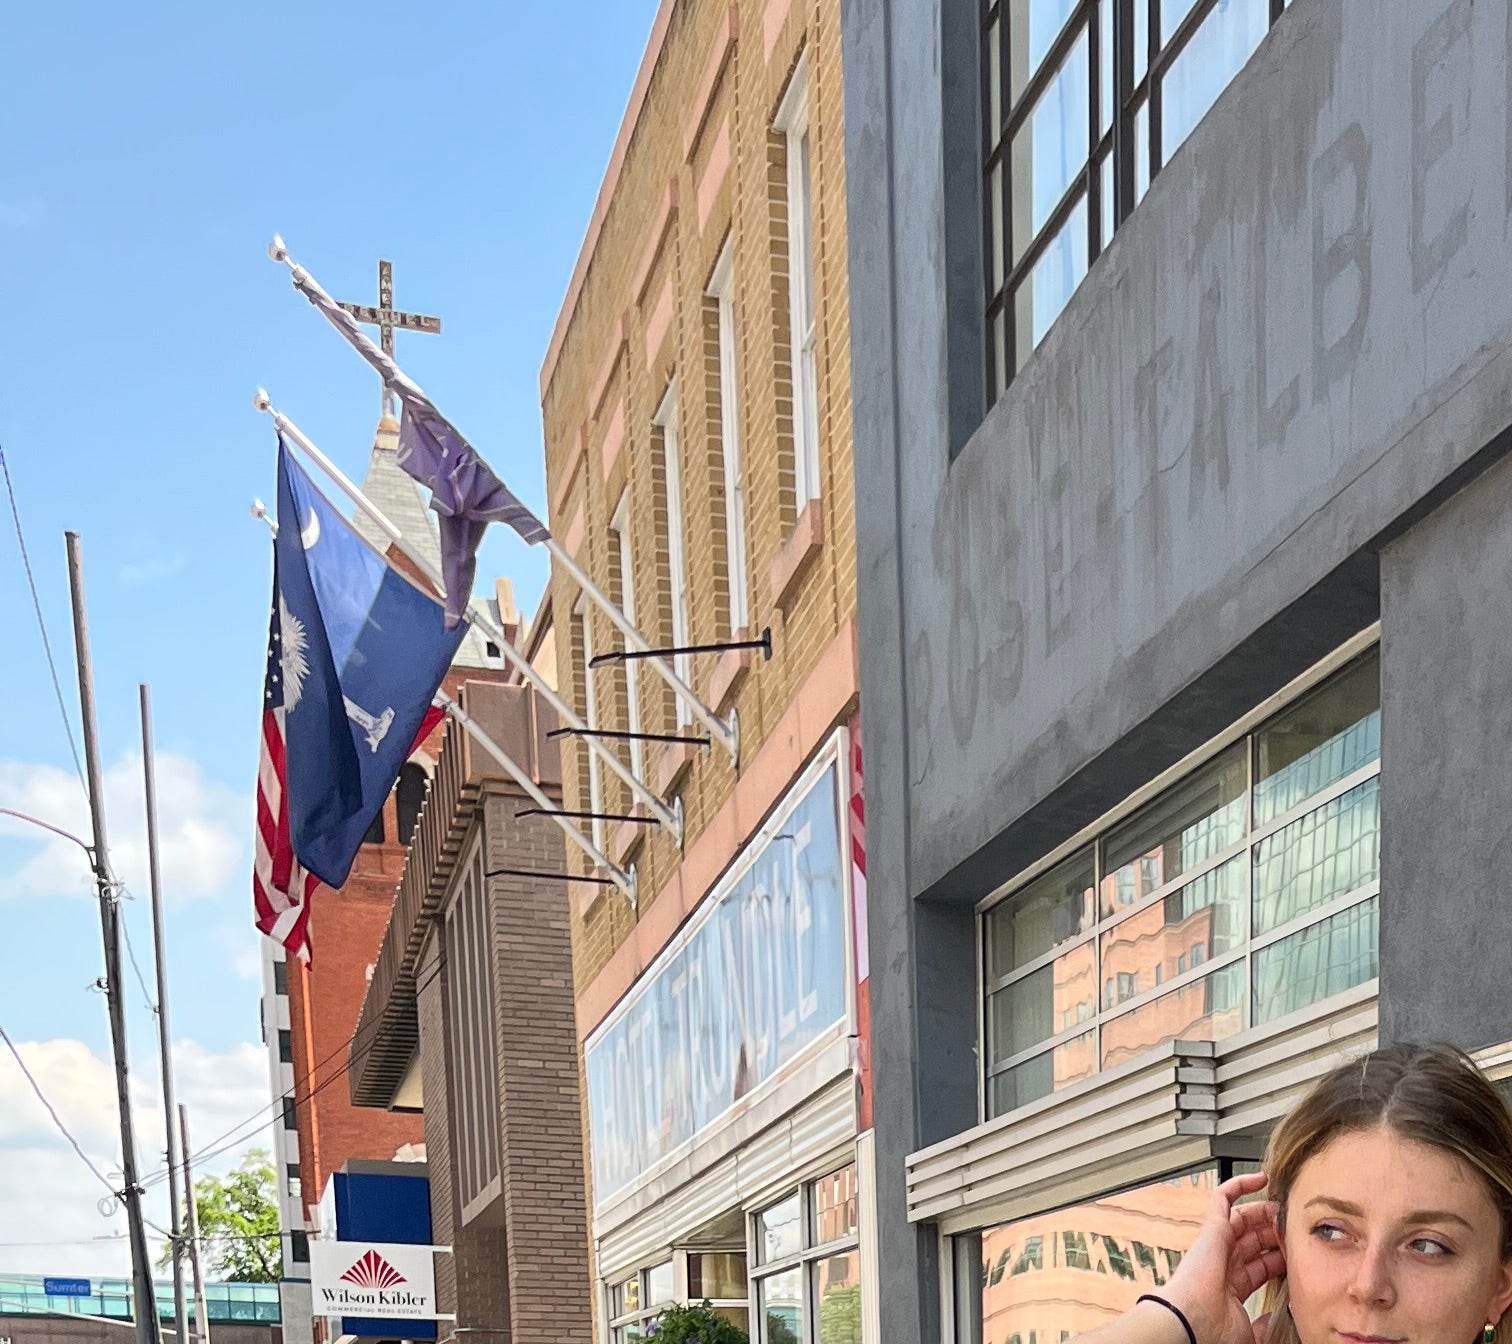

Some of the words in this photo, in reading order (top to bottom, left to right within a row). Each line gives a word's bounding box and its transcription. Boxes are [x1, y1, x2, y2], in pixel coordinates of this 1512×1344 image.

[671, 820, 818, 1124] TRUNDLE
[45, 1280, 90, 1294] Sumter
[321, 1288, 375, 1305] Wilson
[379, 1290, 427, 1306] Kibler
[326, 1305, 375, 1314] COMMERCIAL
[377, 1307, 395, 1315] REAL
[397, 1308, 423, 1316] ESTATE
